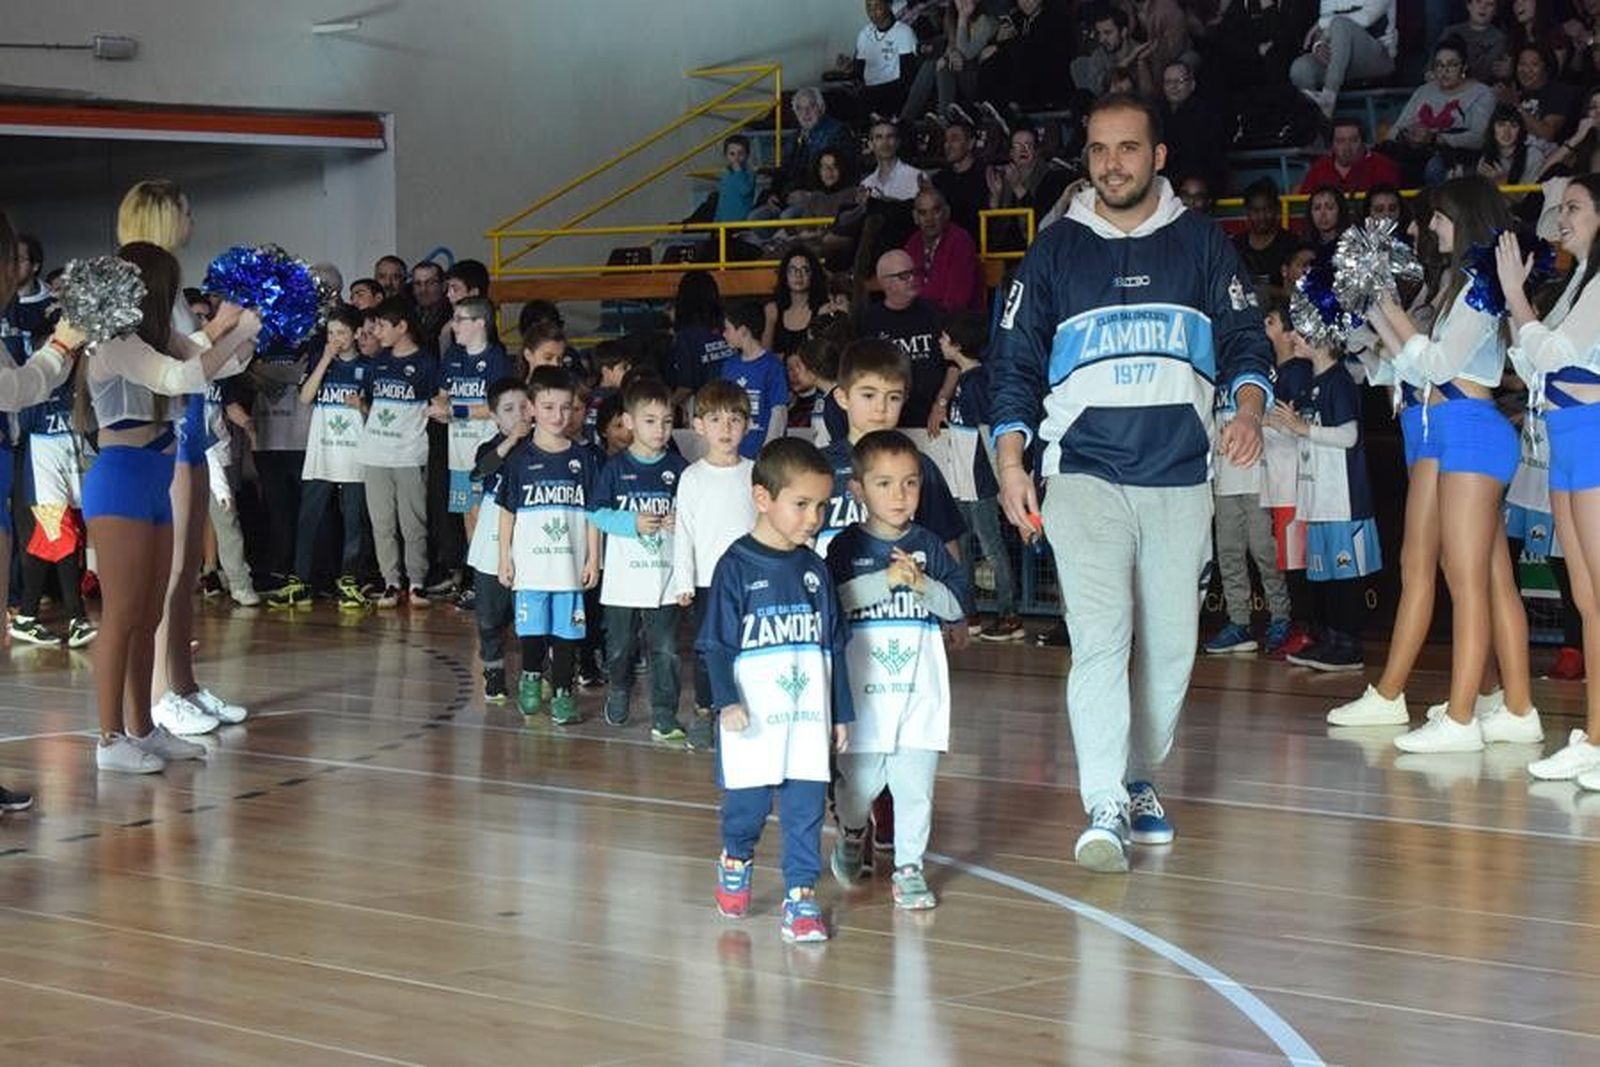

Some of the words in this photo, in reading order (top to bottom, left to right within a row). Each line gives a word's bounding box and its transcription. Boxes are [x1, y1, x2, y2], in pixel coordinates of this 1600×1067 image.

[1074, 311, 1188, 360] ZAMORA
[1112, 363, 1157, 385] 1977
[522, 484, 585, 507] ZAMORA
